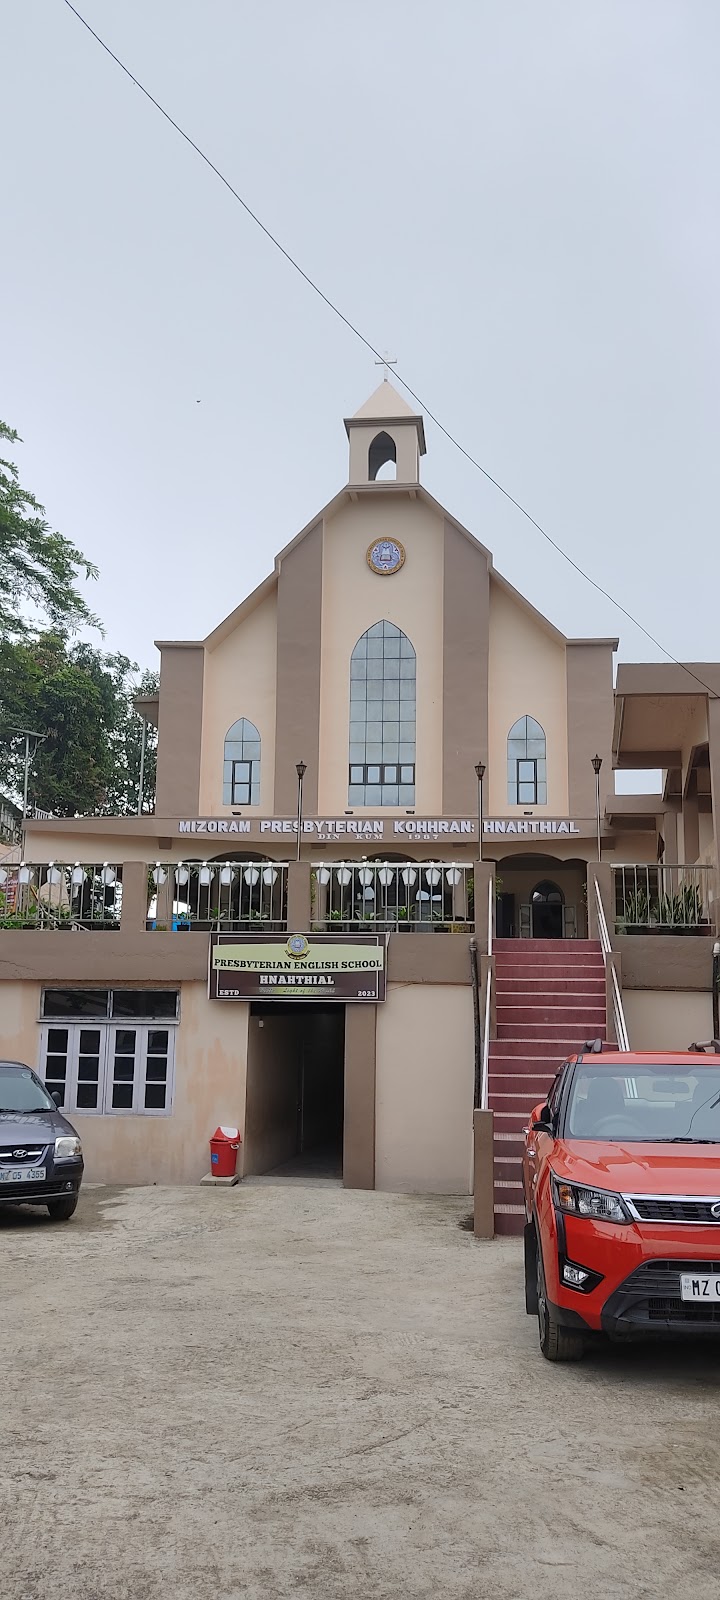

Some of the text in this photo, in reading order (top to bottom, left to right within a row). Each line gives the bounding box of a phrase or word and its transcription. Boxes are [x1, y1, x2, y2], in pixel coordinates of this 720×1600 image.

[178, 820, 580, 833] MIZORAM PRESBYTERIAN KOHHRAN: HNAHTHIAL
[214, 958, 382, 970] PRESBYTERIAN ENGLISH SCHOOL
[259, 975, 335, 985] HNAHTHIAL
[26, 1170, 45, 1179] 4355
[691, 1280, 709, 1296] MZ
